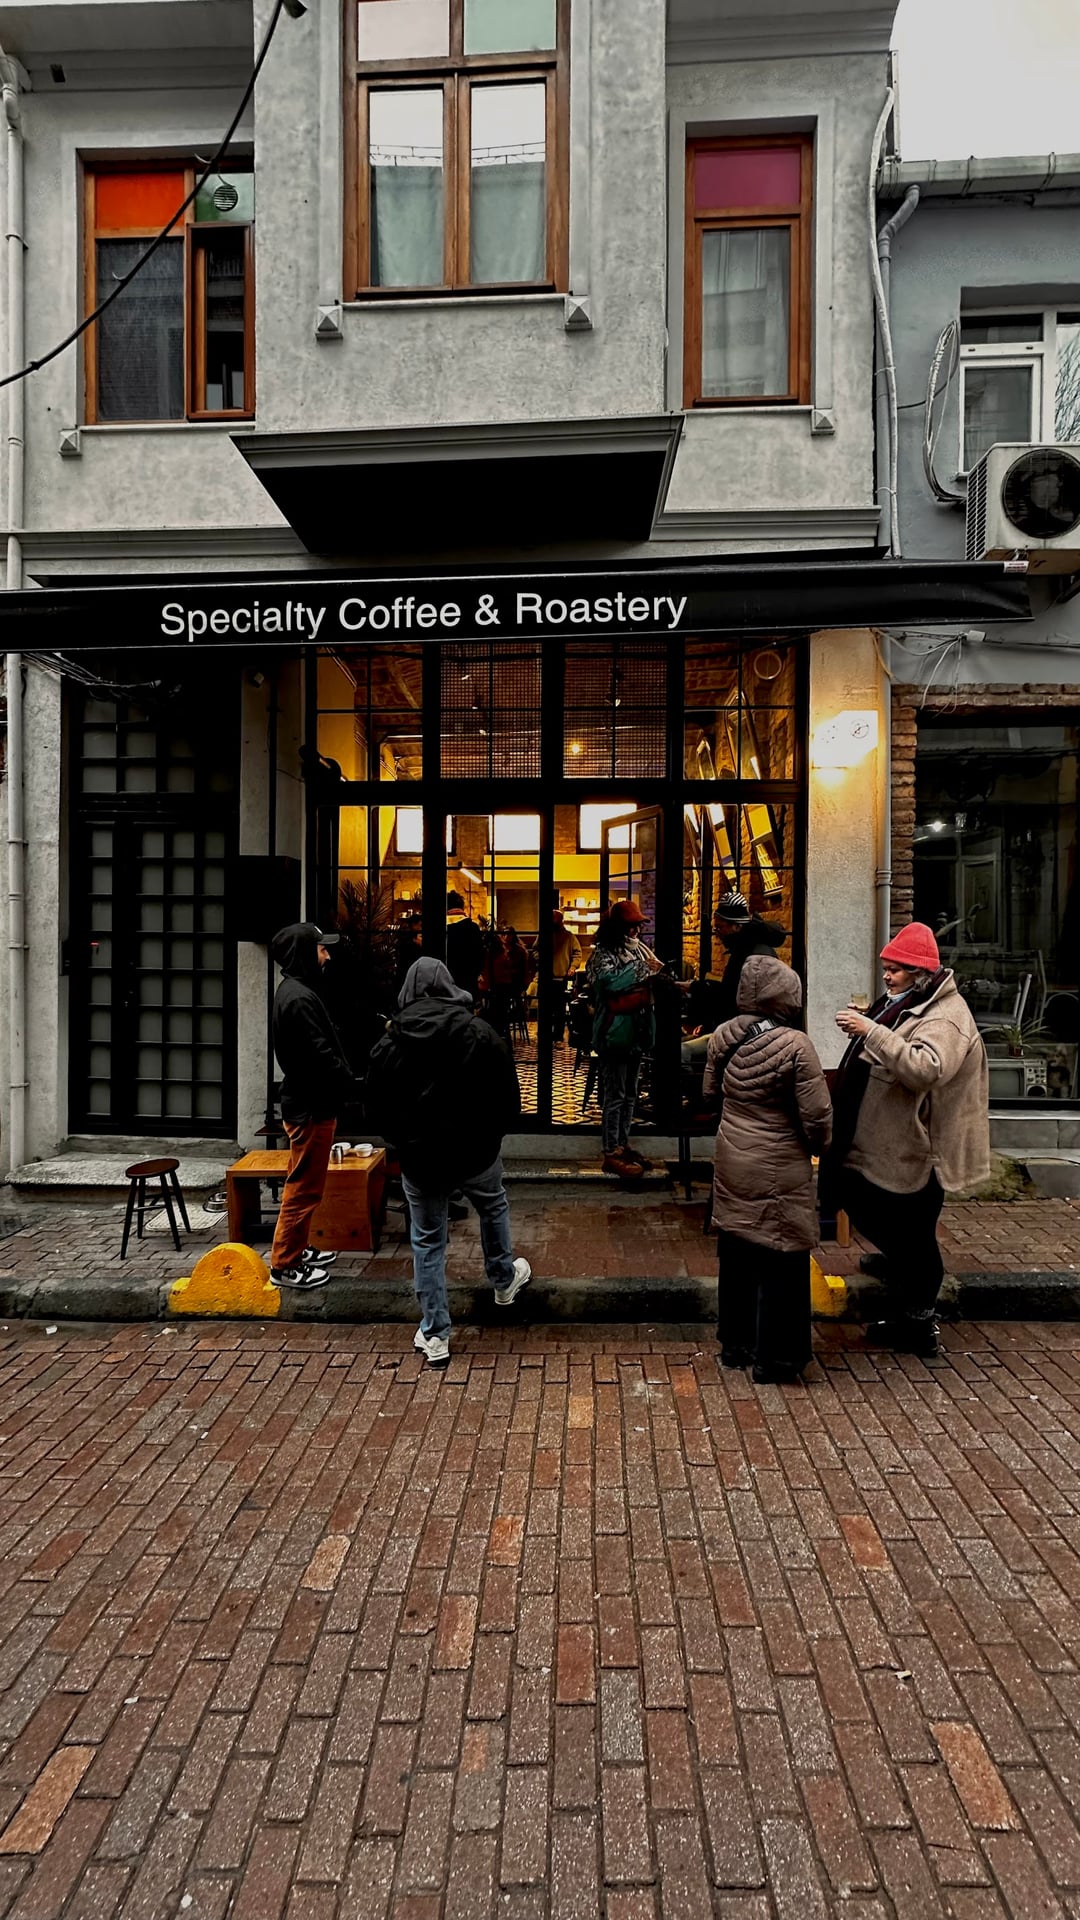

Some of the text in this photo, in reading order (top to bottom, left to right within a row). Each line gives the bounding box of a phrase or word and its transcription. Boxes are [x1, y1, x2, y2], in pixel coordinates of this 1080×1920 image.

[160, 591, 688, 642] Specialty Coffee & Roastery
